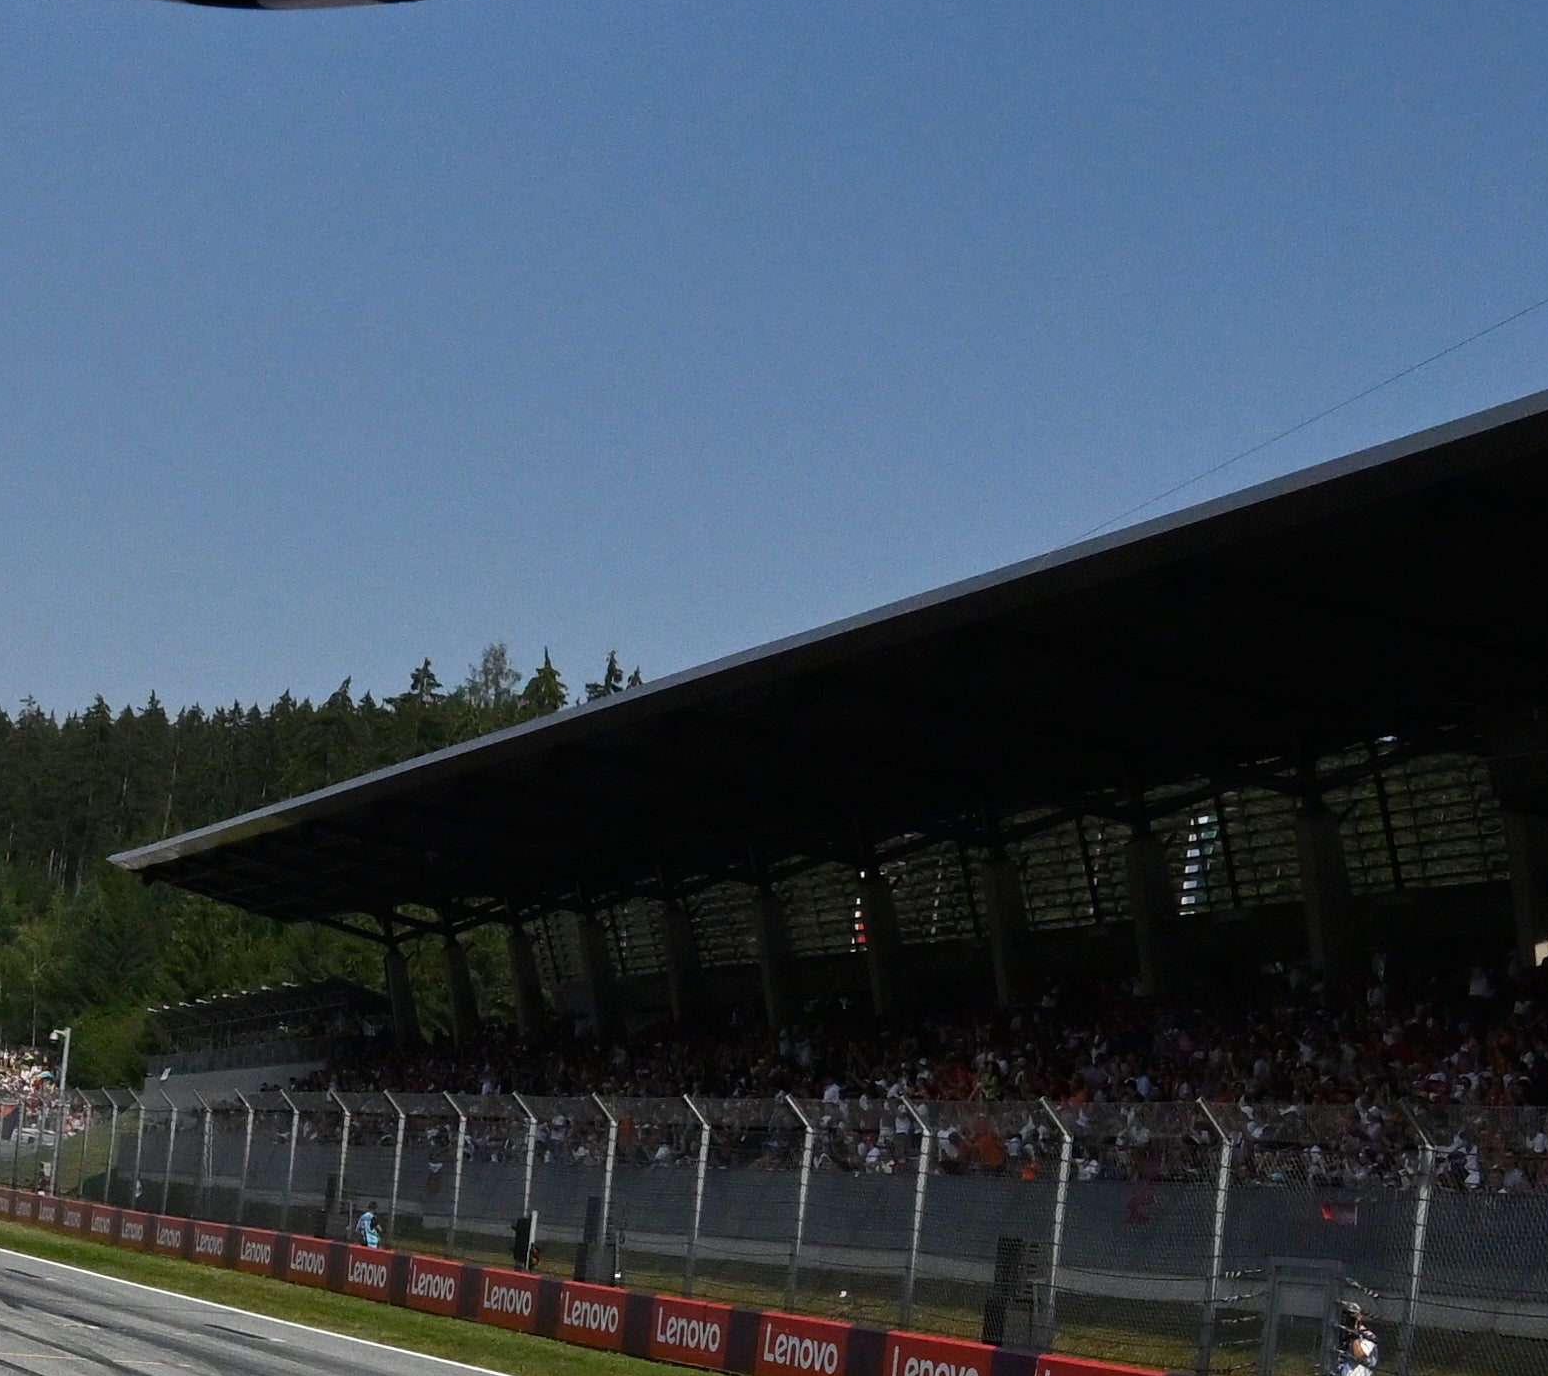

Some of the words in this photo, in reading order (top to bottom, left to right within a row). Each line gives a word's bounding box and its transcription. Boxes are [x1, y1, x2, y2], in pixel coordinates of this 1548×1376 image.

[157, 1223, 180, 1247] Lenovo
[195, 1228, 223, 1255] Lenovo
[240, 1236, 270, 1264] Lenovo
[291, 1243, 325, 1275] Lenovo
[348, 1254, 386, 1287] Lenovo
[412, 1270, 455, 1301] Lenovo
[484, 1277, 532, 1316] Lenovo
[564, 1297, 618, 1333] Lenovo
[657, 1307, 720, 1352] Lenovo
[763, 1322, 838, 1375] Lenovo
